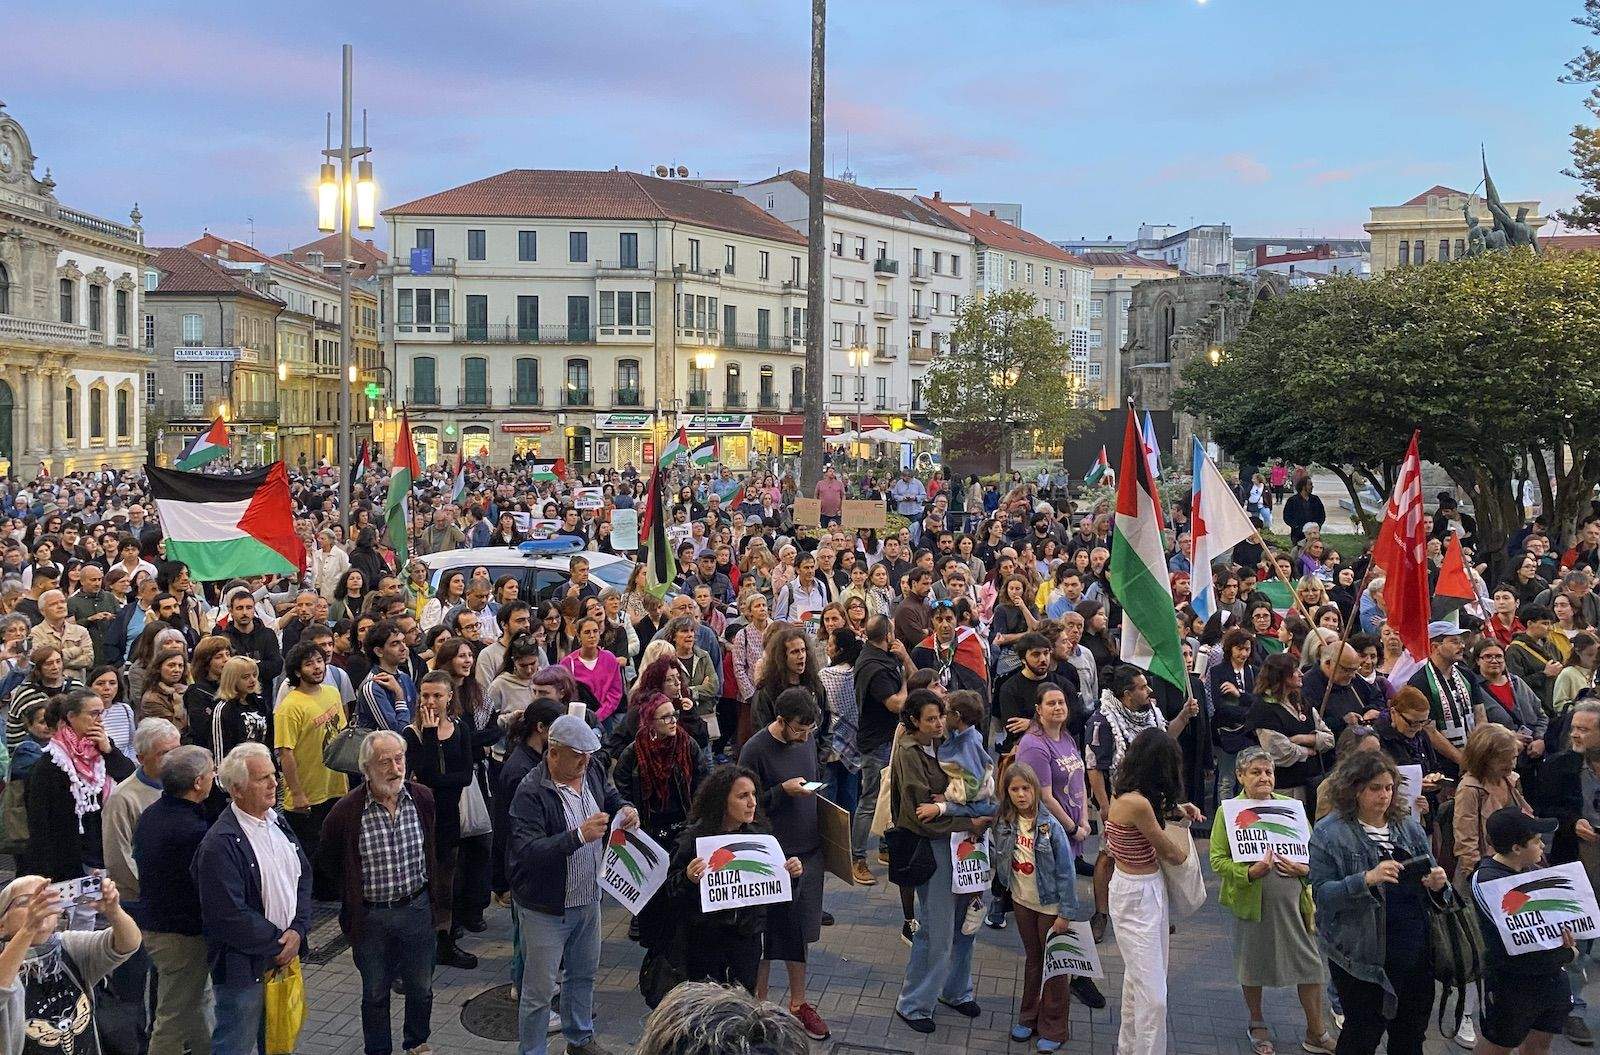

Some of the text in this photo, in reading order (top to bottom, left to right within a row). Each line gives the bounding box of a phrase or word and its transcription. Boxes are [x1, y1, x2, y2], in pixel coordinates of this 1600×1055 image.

[1235, 828, 1268, 842] GALIZA
[1237, 842, 1308, 856] CON PALESTINA
[957, 859, 982, 874] GALIZA
[604, 867, 640, 904] ALESTINA
[707, 869, 741, 887] GALIZA
[958, 873, 974, 887] CON
[708, 880, 783, 903] CON PALESTINA
[1505, 910, 1546, 931] GALIZA
[1511, 915, 1596, 946] CON PALESTINA
[1046, 958, 1094, 973] PALESTINA
